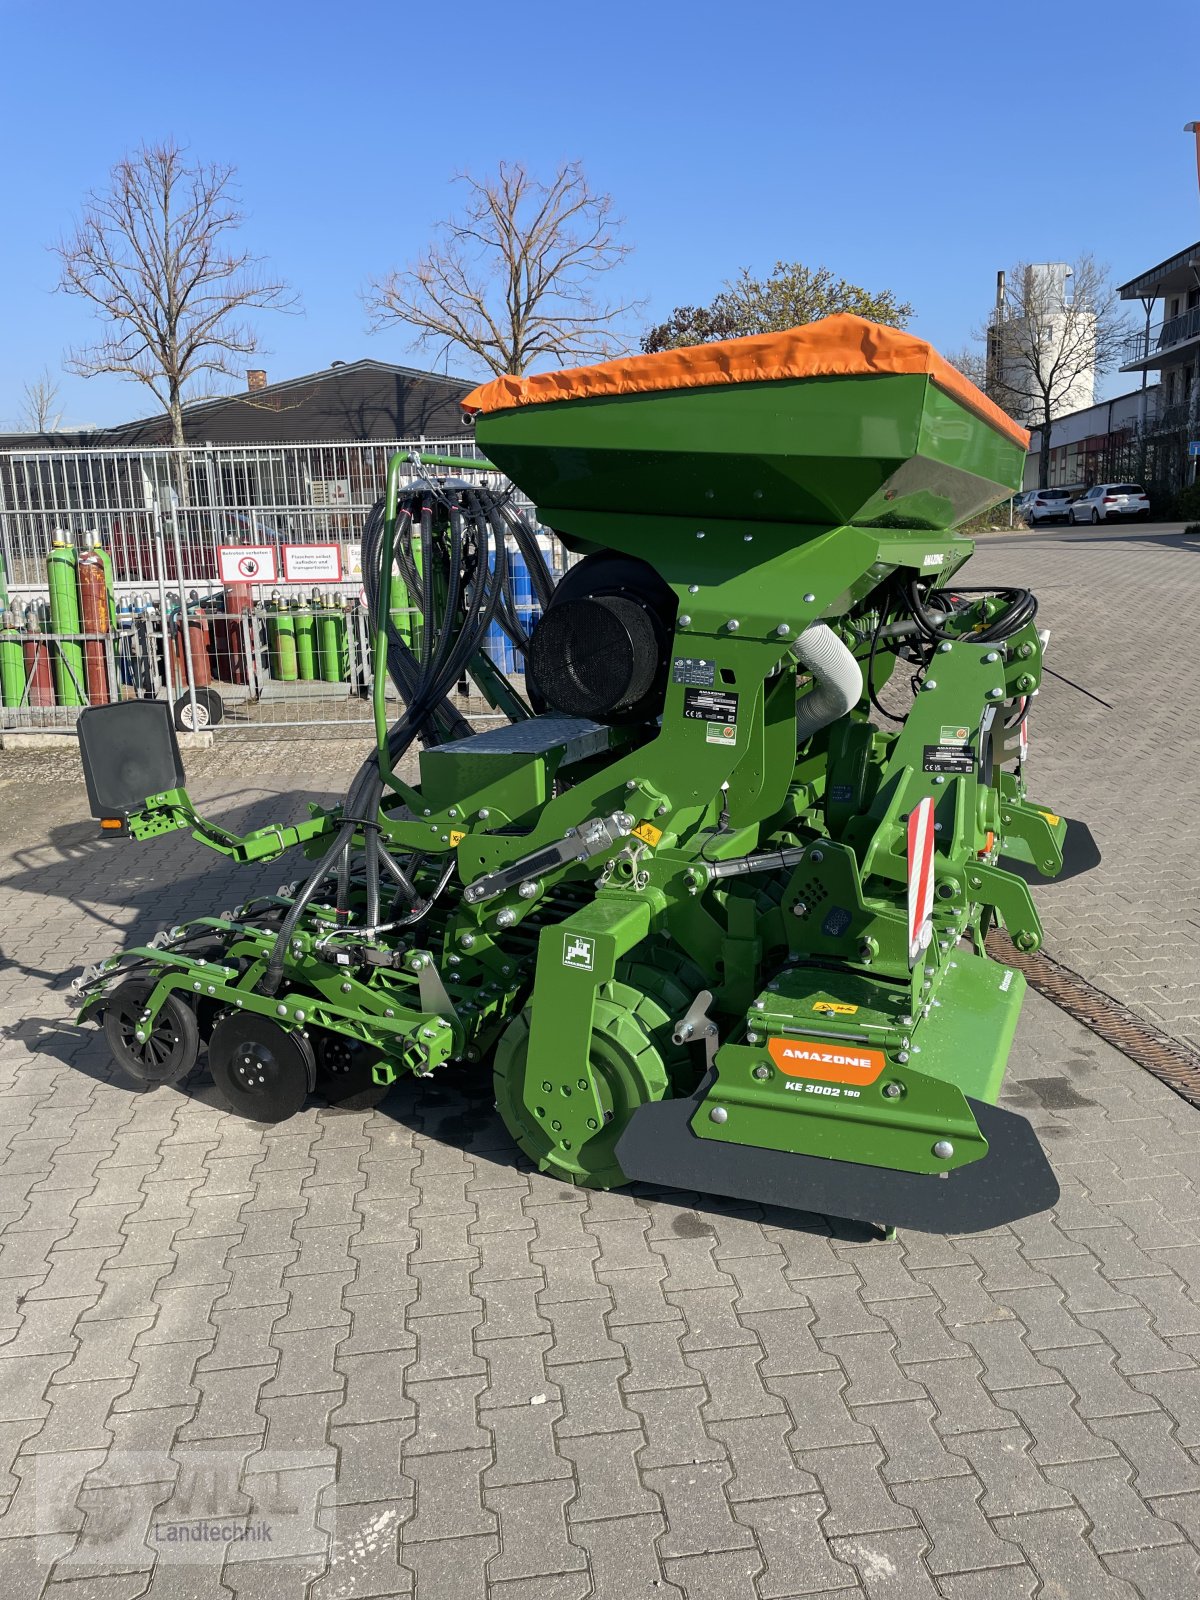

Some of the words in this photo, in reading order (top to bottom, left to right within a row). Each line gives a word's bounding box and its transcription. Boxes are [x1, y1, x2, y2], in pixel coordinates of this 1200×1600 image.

[782, 1049, 872, 1068] AMAZONE
[785, 1081, 803, 1092] KE
[805, 1084, 841, 1097] 3002
